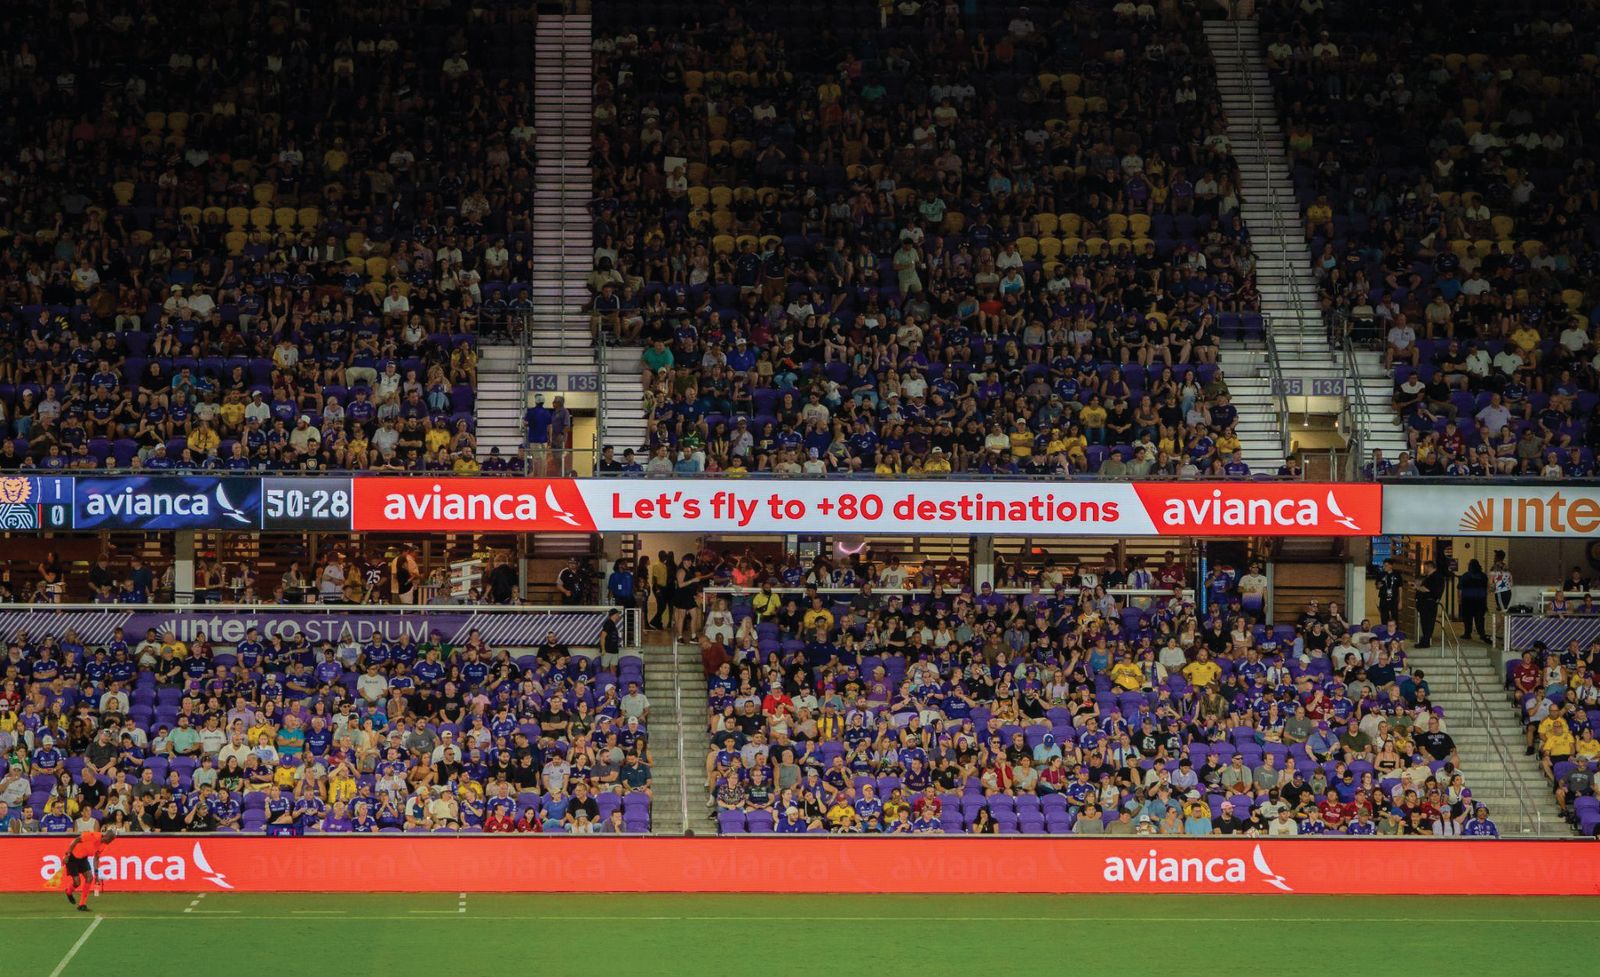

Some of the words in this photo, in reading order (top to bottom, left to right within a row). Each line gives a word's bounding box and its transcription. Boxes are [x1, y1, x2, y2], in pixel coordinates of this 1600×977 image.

[527, 375, 556, 390] 134
[569, 376, 598, 390] 135
[1314, 380, 1342, 394] 136
[54, 479, 61, 500] 1
[86, 486, 209, 515] avianca
[383, 484, 537, 520] avianca
[51, 504, 65, 526] 0
[267, 489, 350, 518] 50:28
[612, 491, 700, 519] Let’s
[710, 491, 759, 527] fly
[767, 493, 806, 519] to
[816, 493, 884, 520] +80
[893, 493, 1120, 522] destinations
[1162, 489, 1319, 526] avianca
[366, 570, 382, 584] 25
[305, 620, 429, 643] STADIUM
[40, 854, 186, 882] aanca
[1103, 849, 1246, 883] avianca
